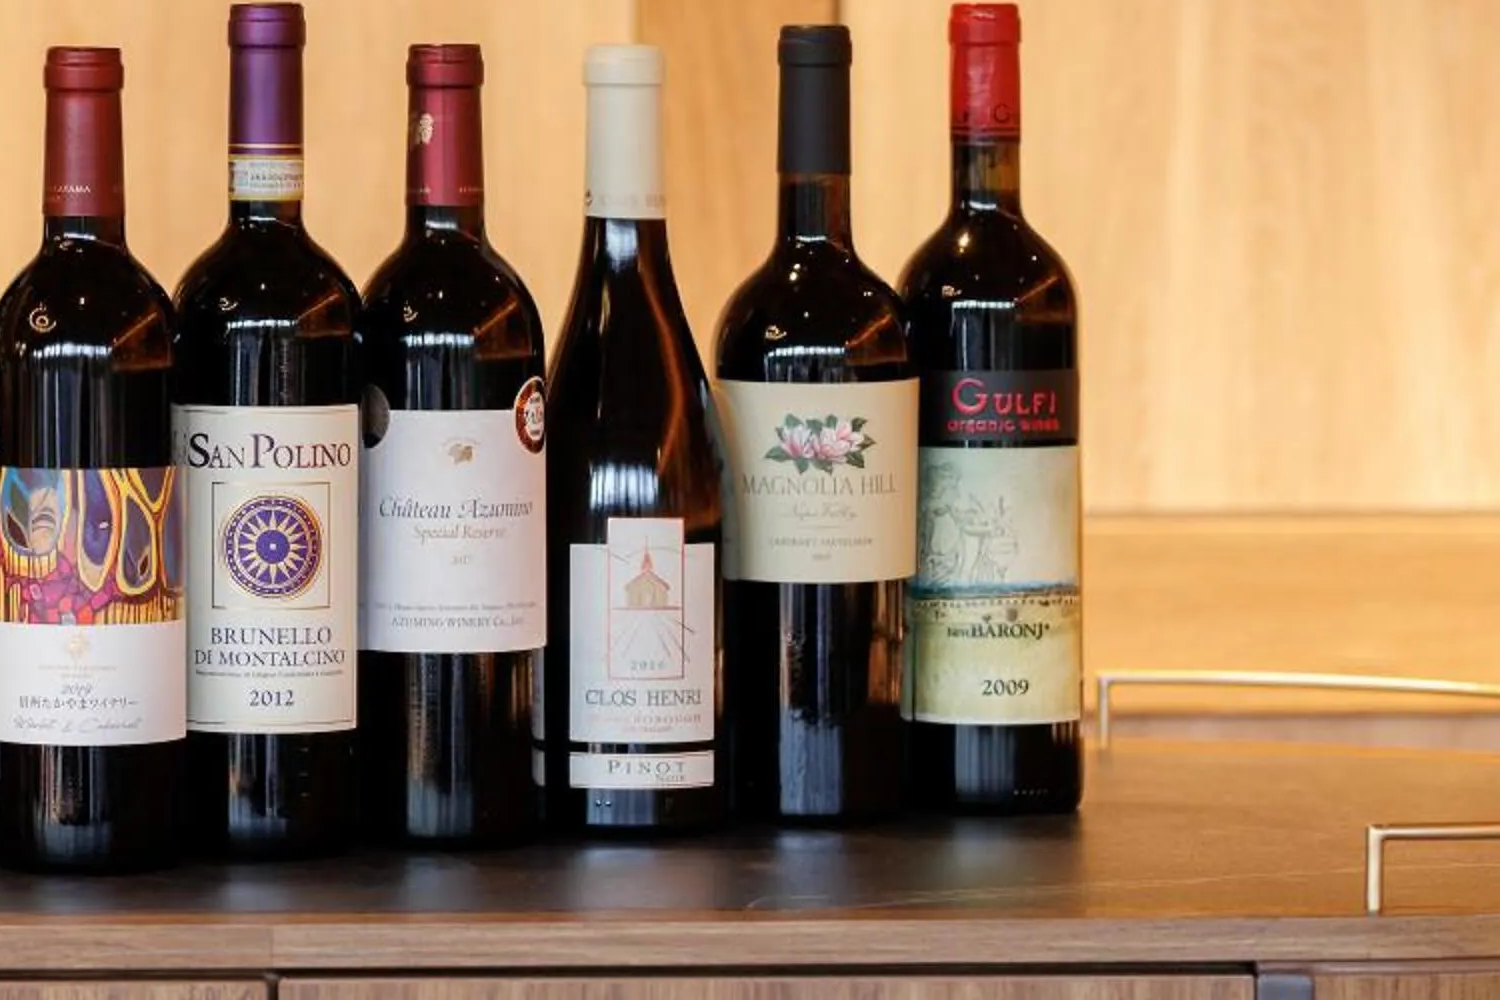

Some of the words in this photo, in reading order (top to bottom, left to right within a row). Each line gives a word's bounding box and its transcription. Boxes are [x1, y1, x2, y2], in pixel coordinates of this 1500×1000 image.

[952, 378, 1056, 415] GULFI
[947, 419, 1015, 433] organic
[742, 474, 854, 496] MAGNOLIA
[861, 474, 897, 495] HILL
[211, 627, 332, 645] BRUNELLO
[195, 650, 213, 665] DI
[219, 650, 345, 667] MONTALCINO
[982, 679, 1029, 696] 2009
[249, 690, 295, 707] 2012
[585, 689, 637, 706] CLOS
[647, 689, 702, 706] HENRI
[608, 760, 684, 774] PINOT
